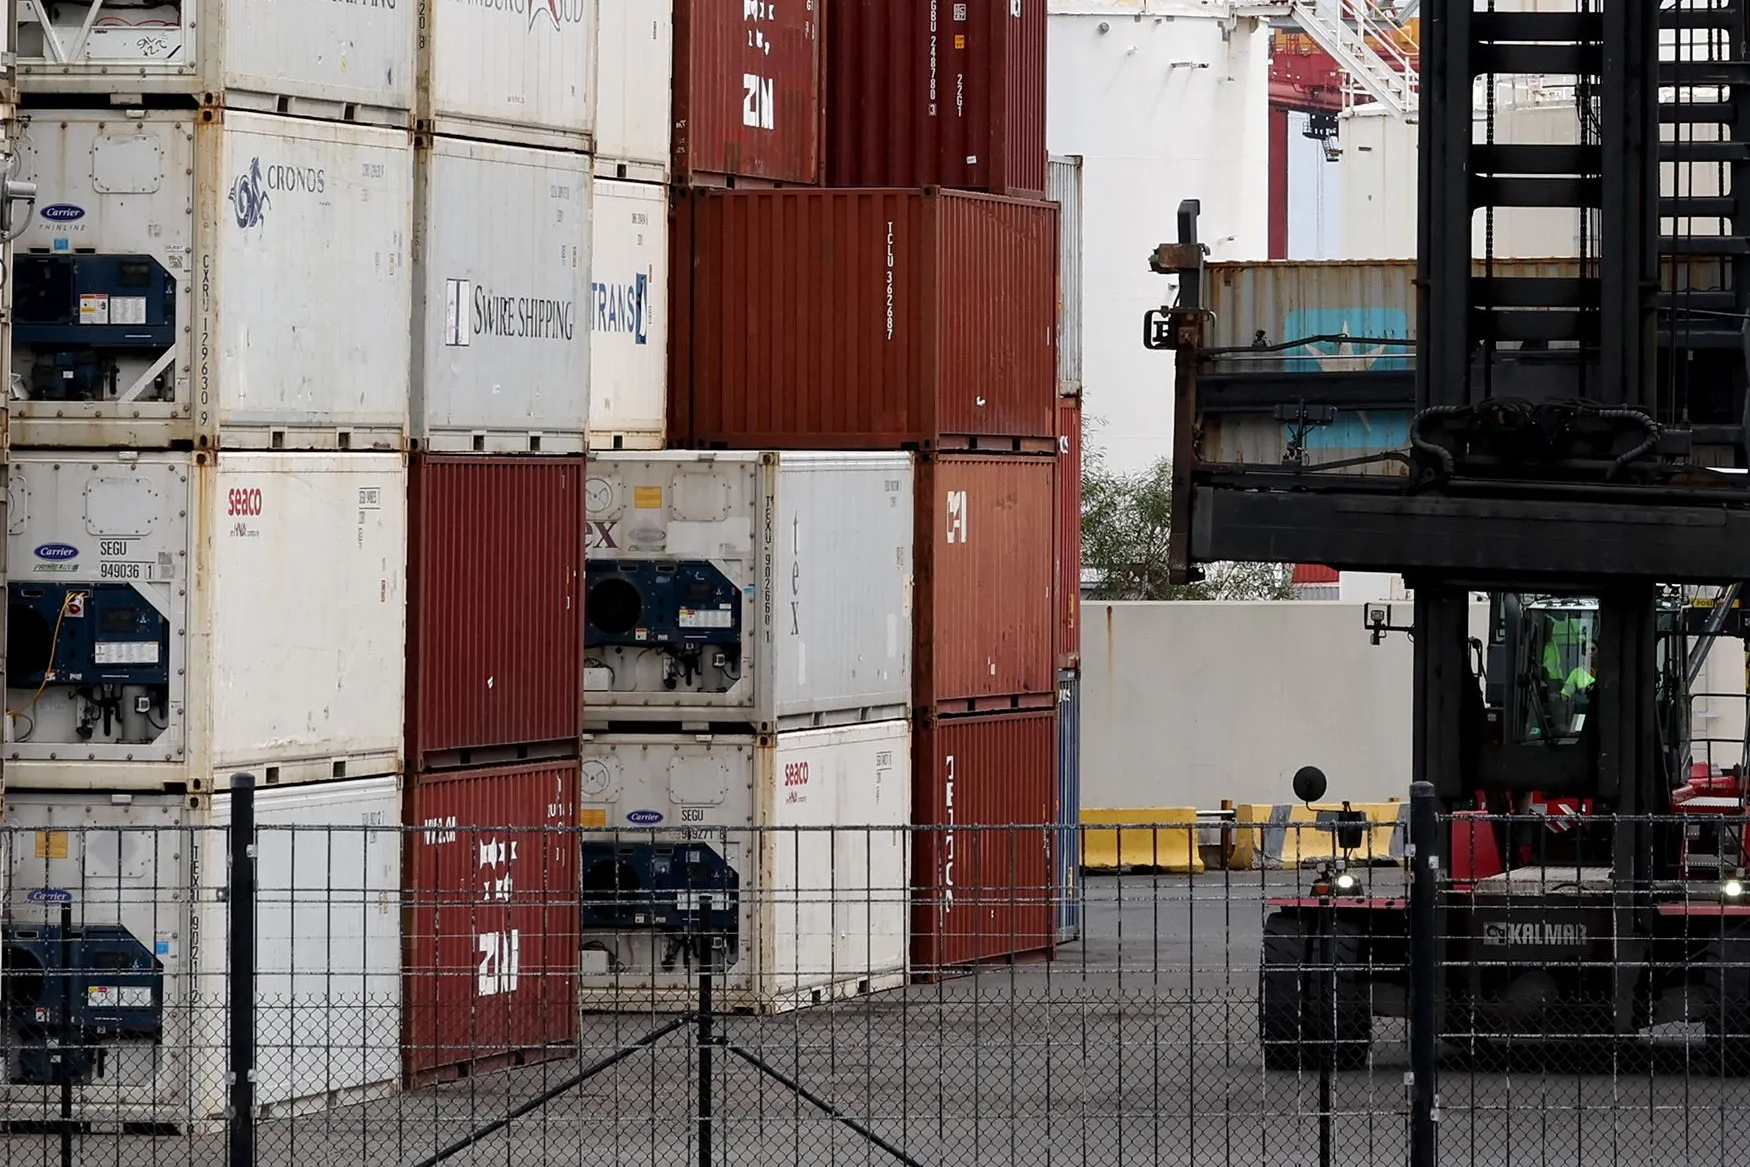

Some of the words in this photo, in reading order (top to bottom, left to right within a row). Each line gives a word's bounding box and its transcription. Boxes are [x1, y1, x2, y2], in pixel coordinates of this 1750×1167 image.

[418, 34, 427, 49] 8
[267, 165, 325, 193] CRONOS
[46, 207, 80, 218] Carrier
[202, 254, 210, 312] CXRU
[474, 285, 515, 336] SWIRE
[518, 298, 573, 341] SHIPPING
[201, 324, 209, 405] 129630
[200, 411, 208, 426] 9
[228, 488, 262, 516] seaco
[40, 547, 74, 556] Carrier
[100, 541, 127, 556] SEGU
[100, 564, 140, 578] 949036
[790, 508, 799, 635] tex
[785, 762, 809, 786] seaco
[631, 812, 660, 822] Carrier
[681, 809, 704, 822] SEGU
[681, 829, 713, 840] 99271
[1509, 923, 1587, 945] KALMAR
